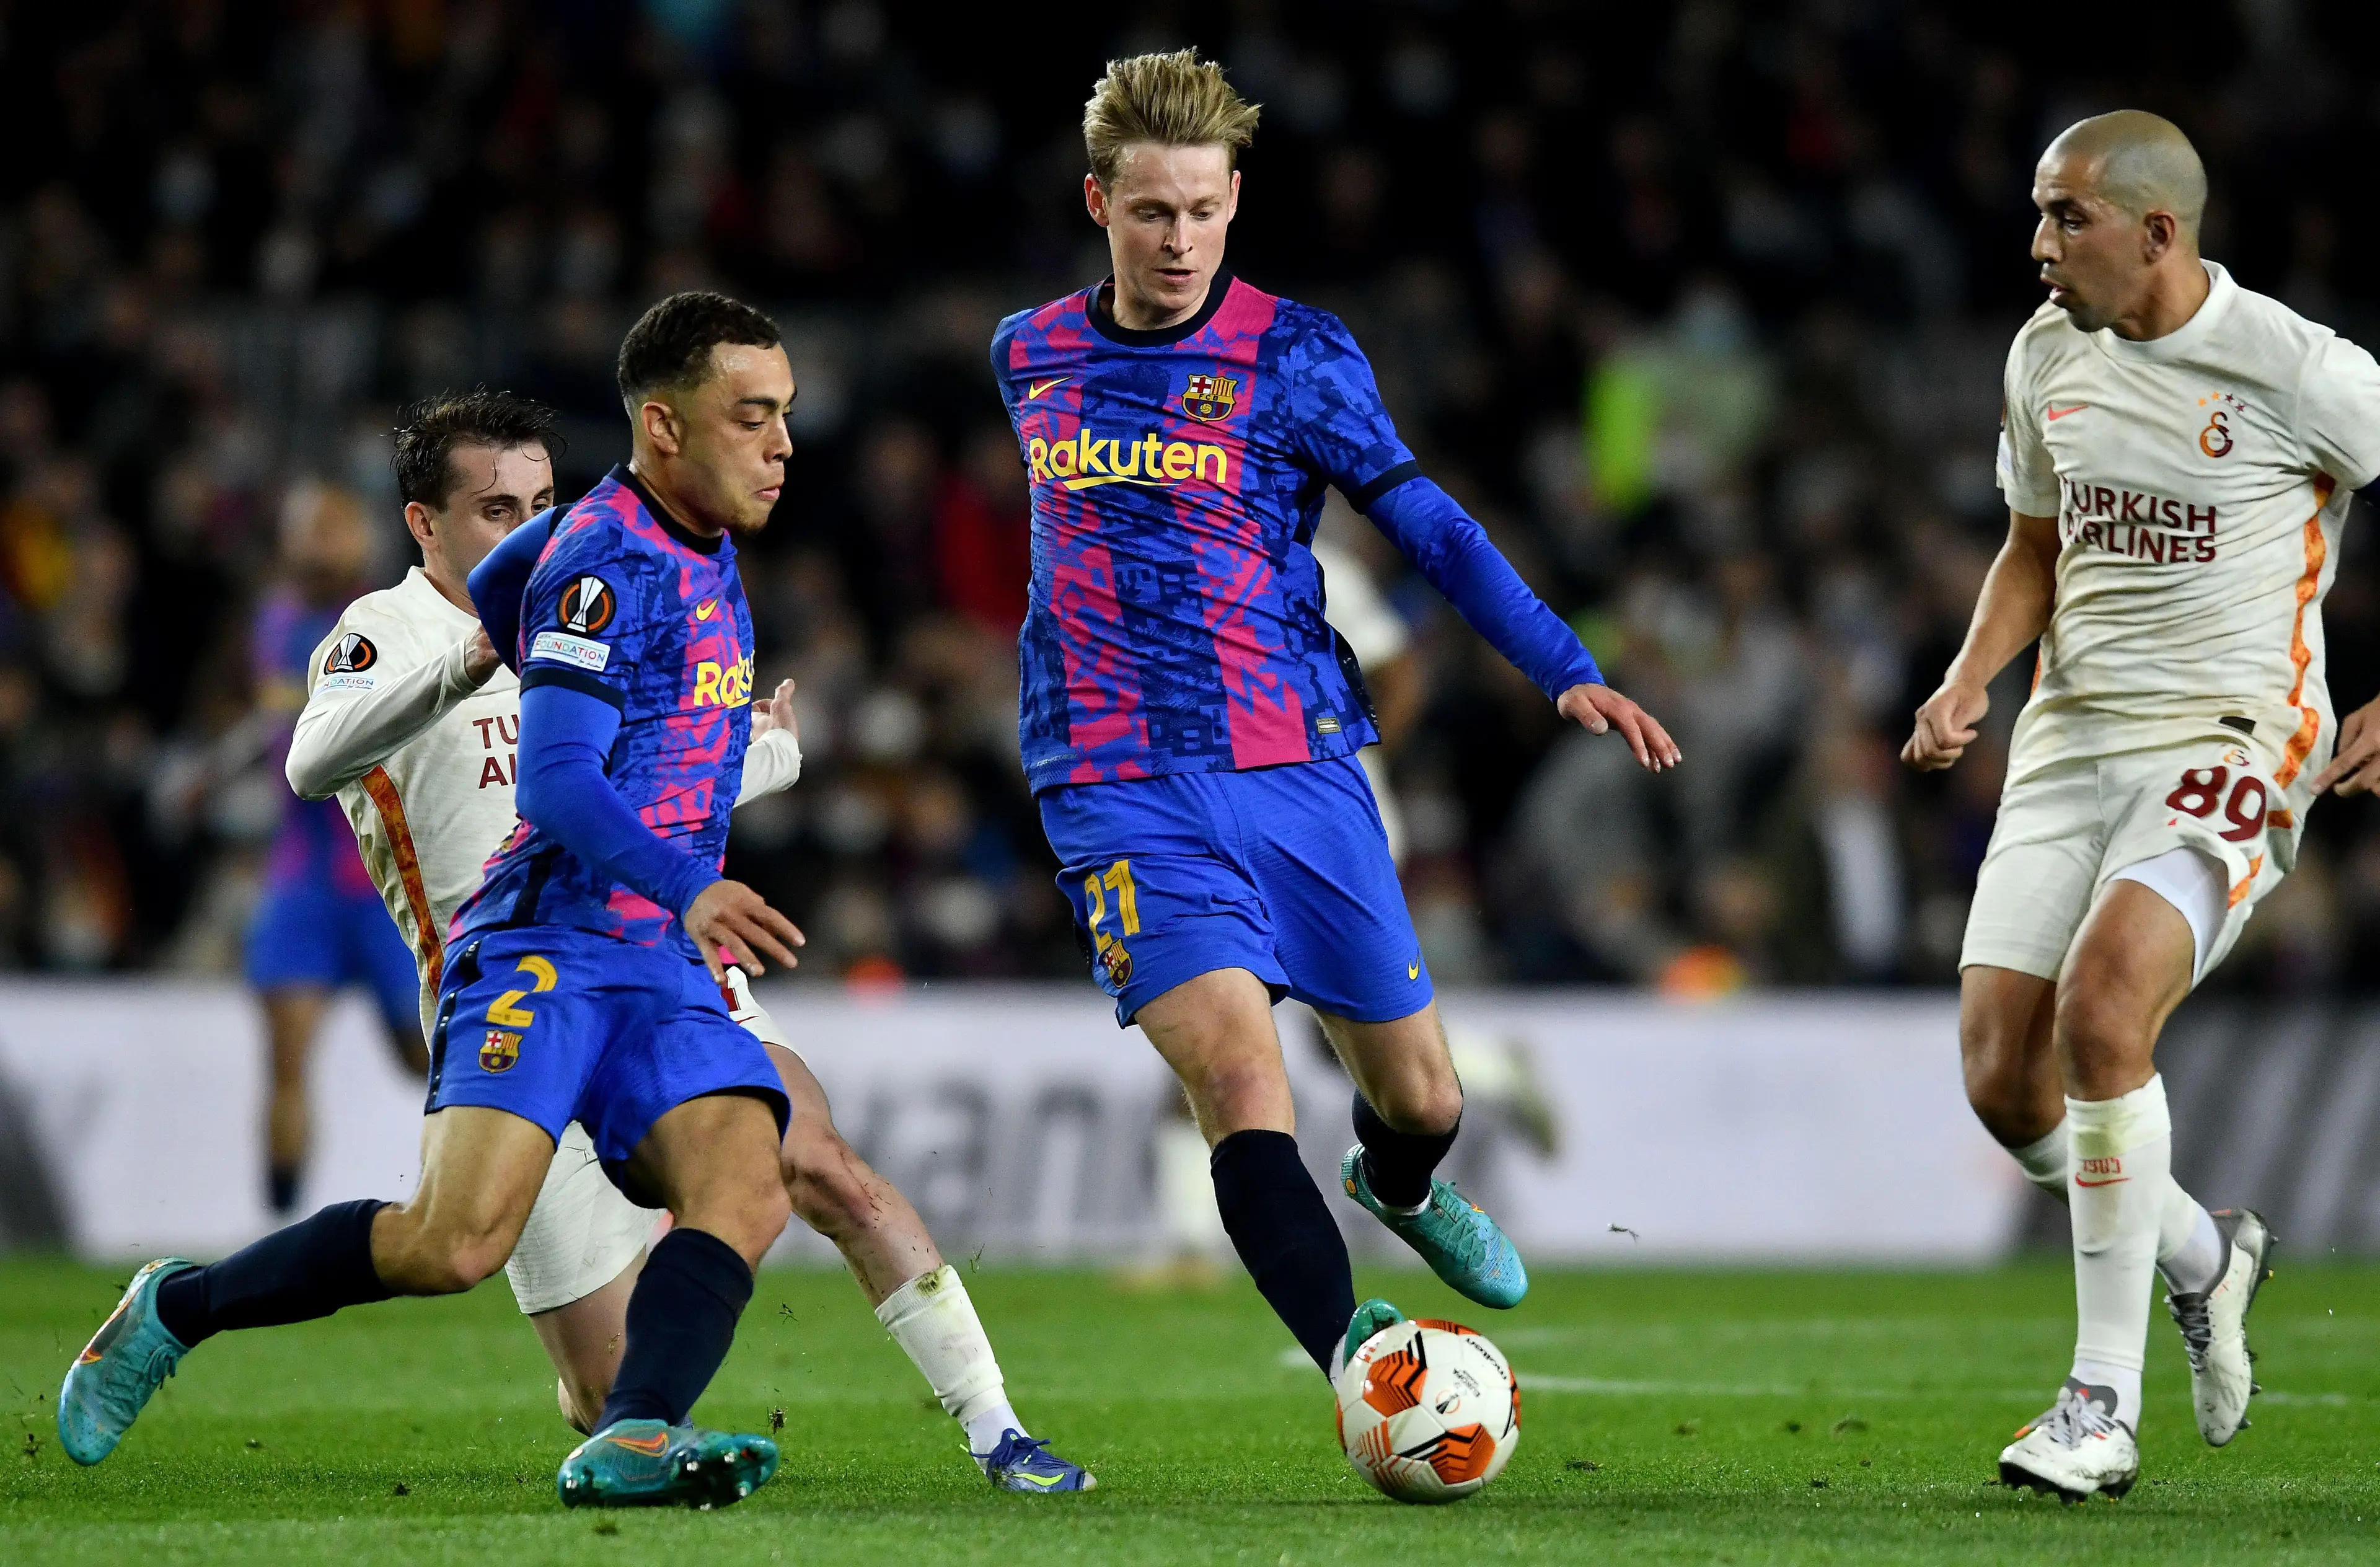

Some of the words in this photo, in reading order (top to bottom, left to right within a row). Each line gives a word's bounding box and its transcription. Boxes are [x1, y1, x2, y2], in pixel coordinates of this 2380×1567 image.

[1029, 429, 1227, 483] Rakuten
[2066, 512, 2216, 563] RLINES
[536, 640, 606, 663] FOUNDATION
[2166, 766, 2266, 841] 89
[1085, 860, 1140, 954] 21
[486, 955, 558, 1027] 2
